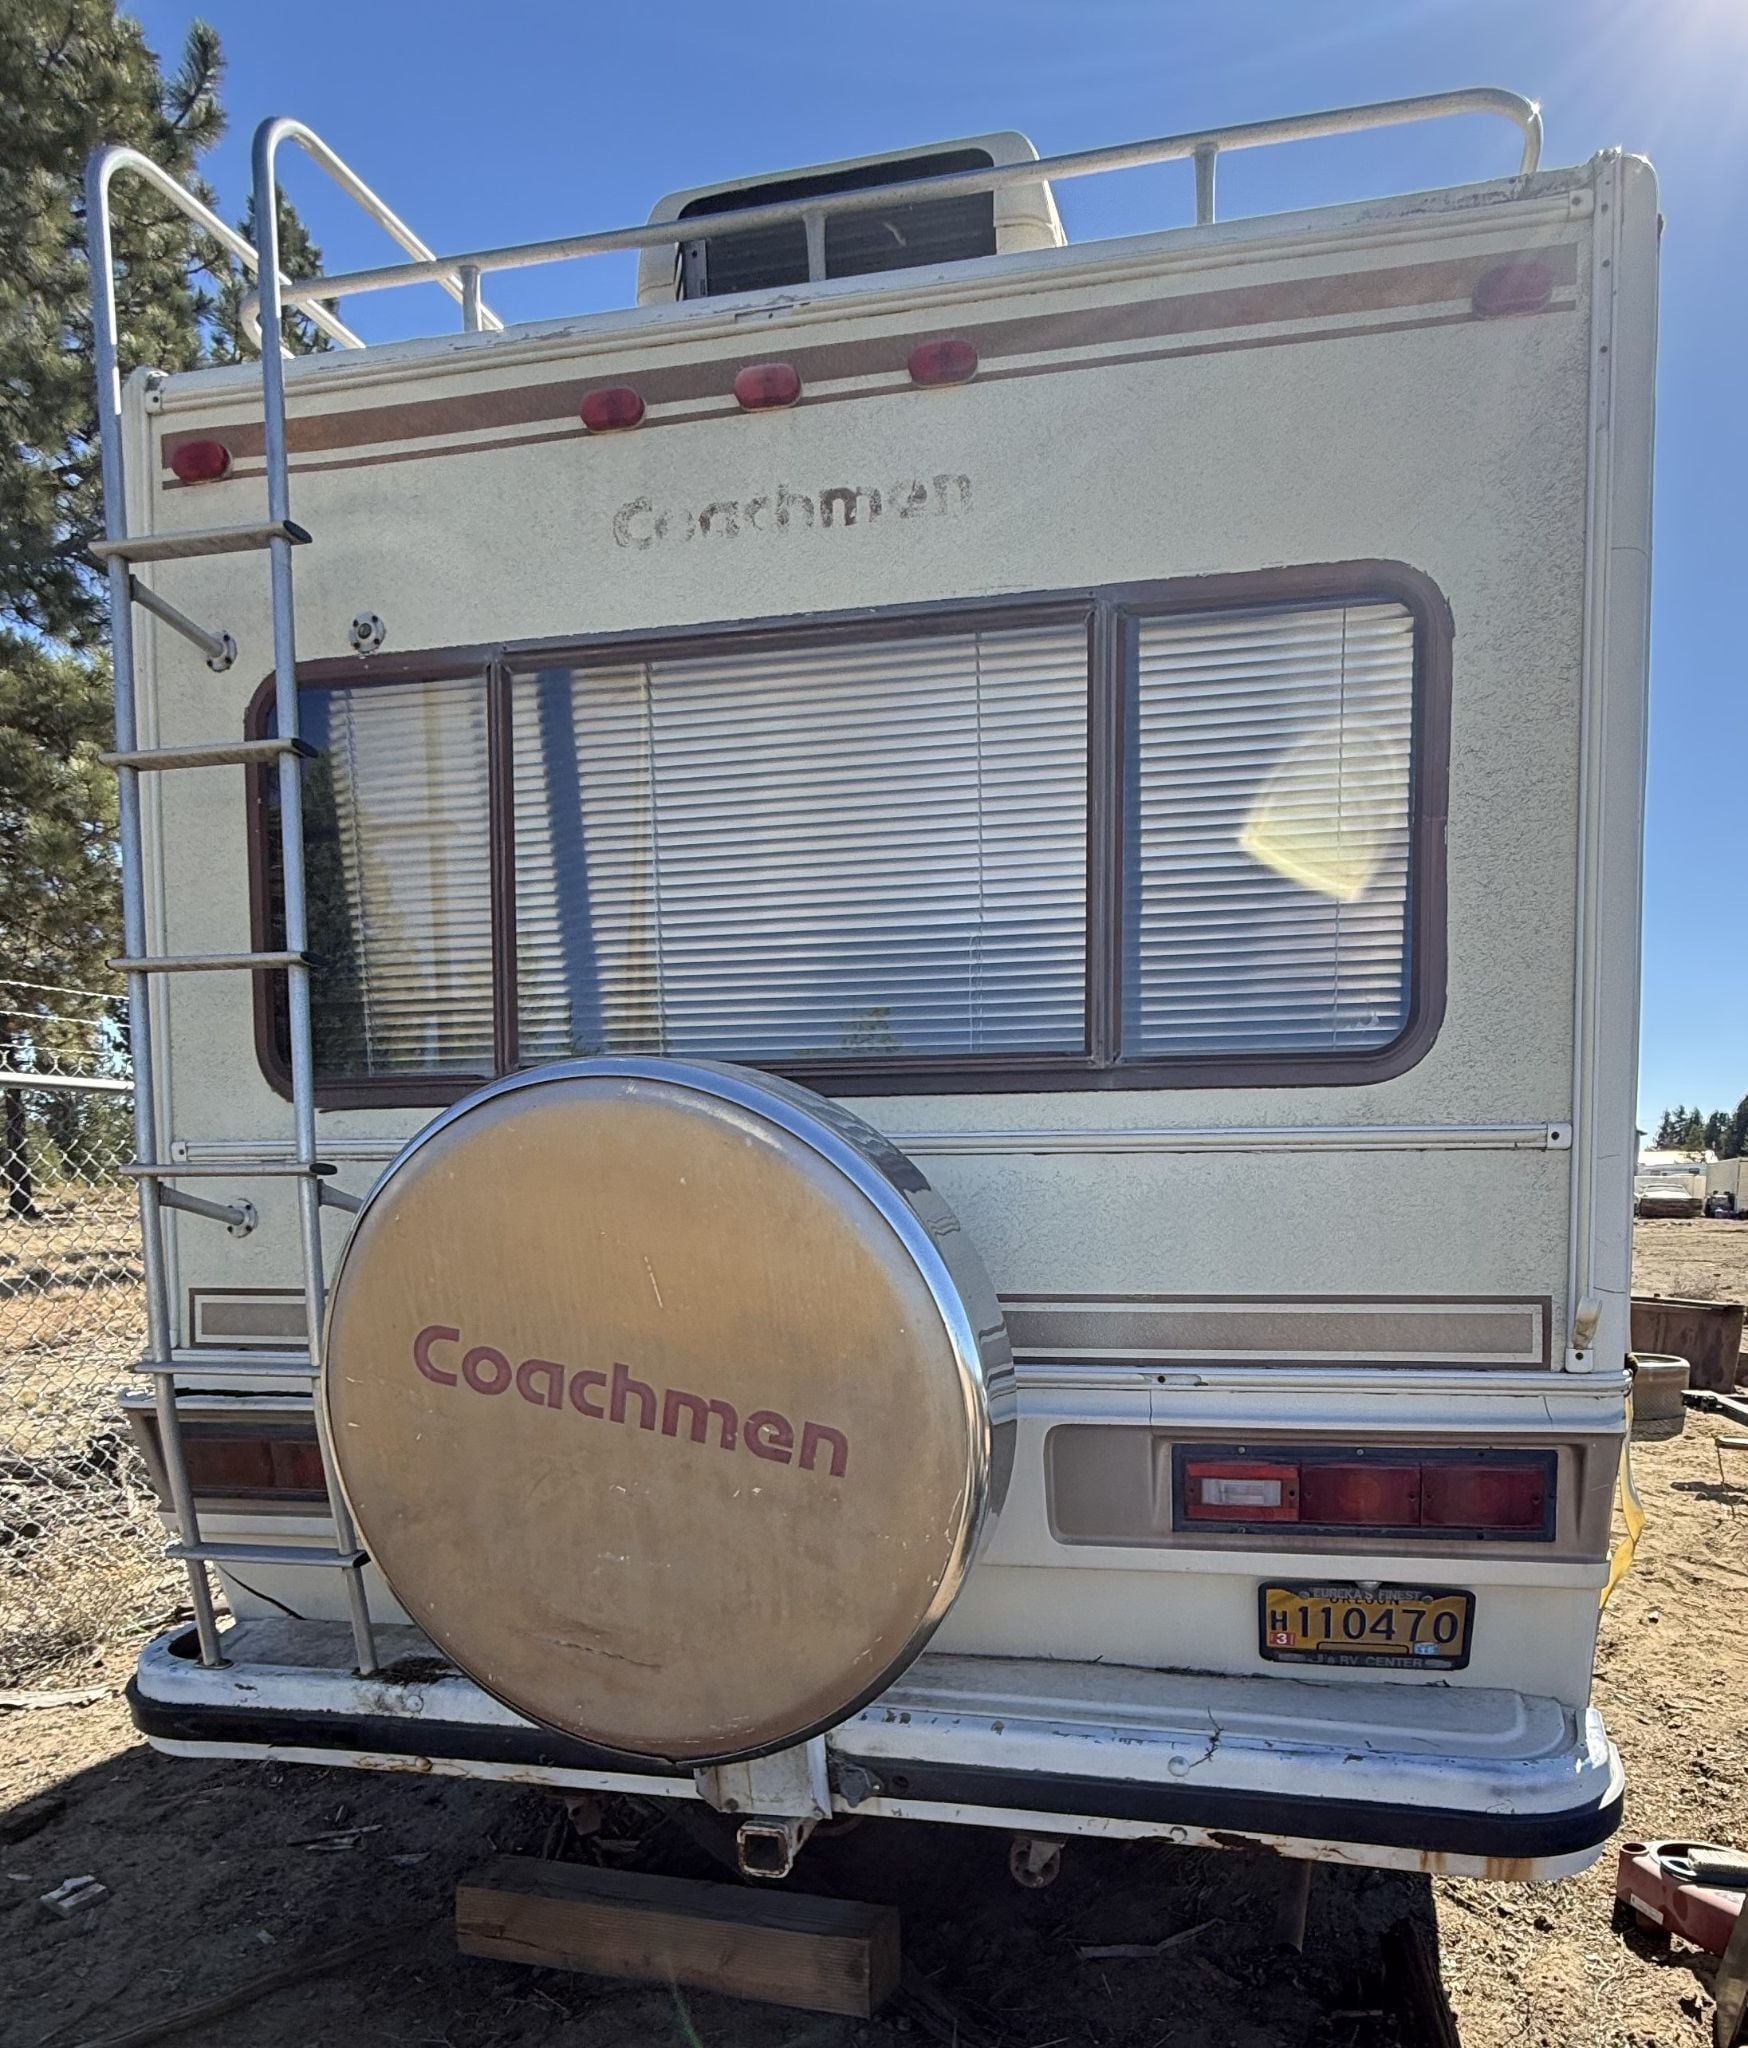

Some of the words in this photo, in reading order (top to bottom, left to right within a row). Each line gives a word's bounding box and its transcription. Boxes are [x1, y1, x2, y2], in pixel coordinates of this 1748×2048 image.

[413, 1325, 848, 1478] Coachmen
[1312, 1588, 1374, 1600] EUREKAS
[1379, 1589, 1421, 1601] FINEST
[1276, 1632, 1288, 1645] 3
[1339, 1655, 1360, 1666] RV
[1365, 1656, 1423, 1669] CENTER
